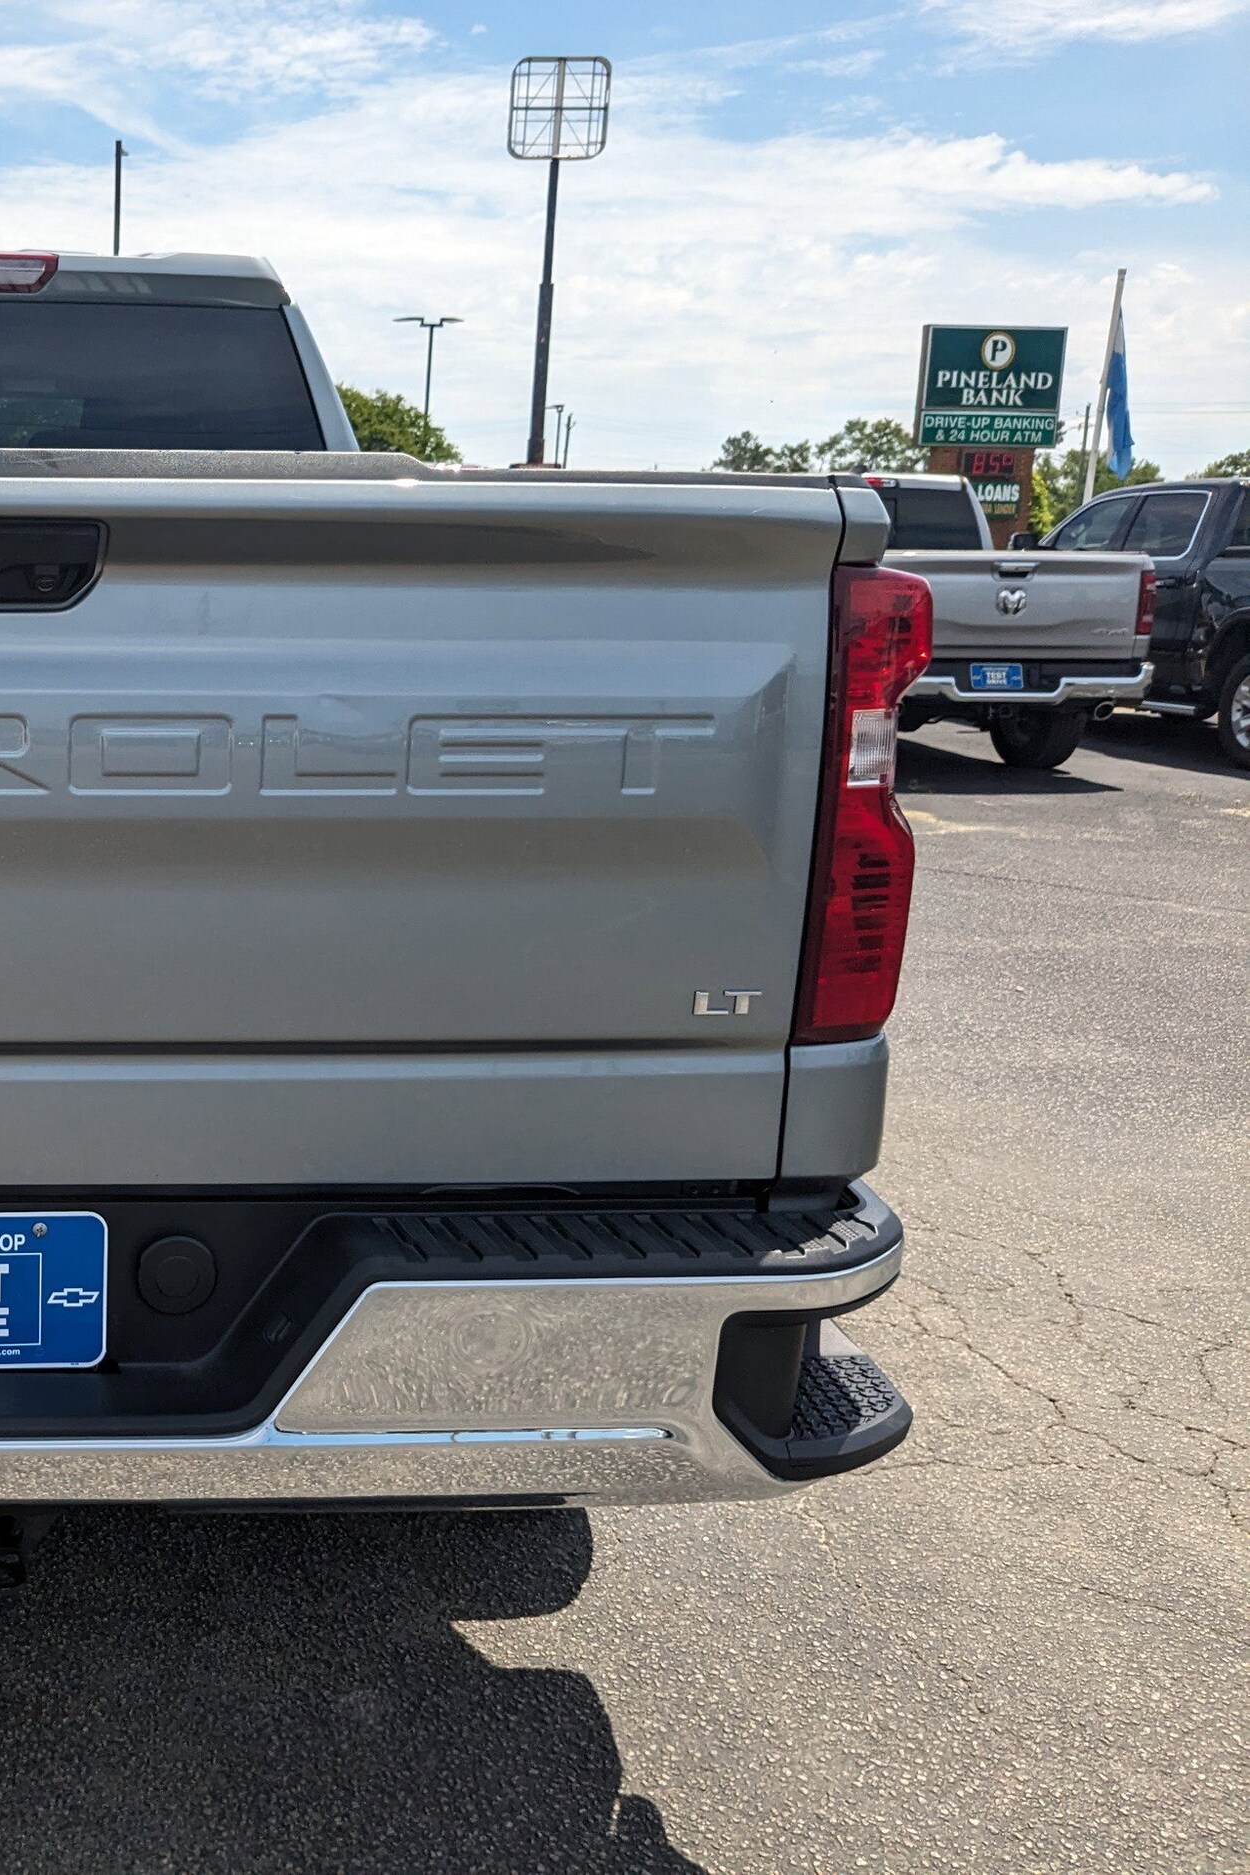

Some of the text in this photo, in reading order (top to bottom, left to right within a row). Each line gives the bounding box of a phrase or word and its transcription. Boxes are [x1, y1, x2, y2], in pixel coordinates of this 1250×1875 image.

[990, 339, 1007, 362] P
[936, 370, 1053, 390] PINELAND
[961, 388, 1023, 406] BANK
[924, 415, 1055, 431] DRIVE-UP BANKING
[935, 430, 1042, 443] & 24 HOUR ATM
[977, 484, 1020, 502] LOANS
[693, 990, 763, 1015] LT
